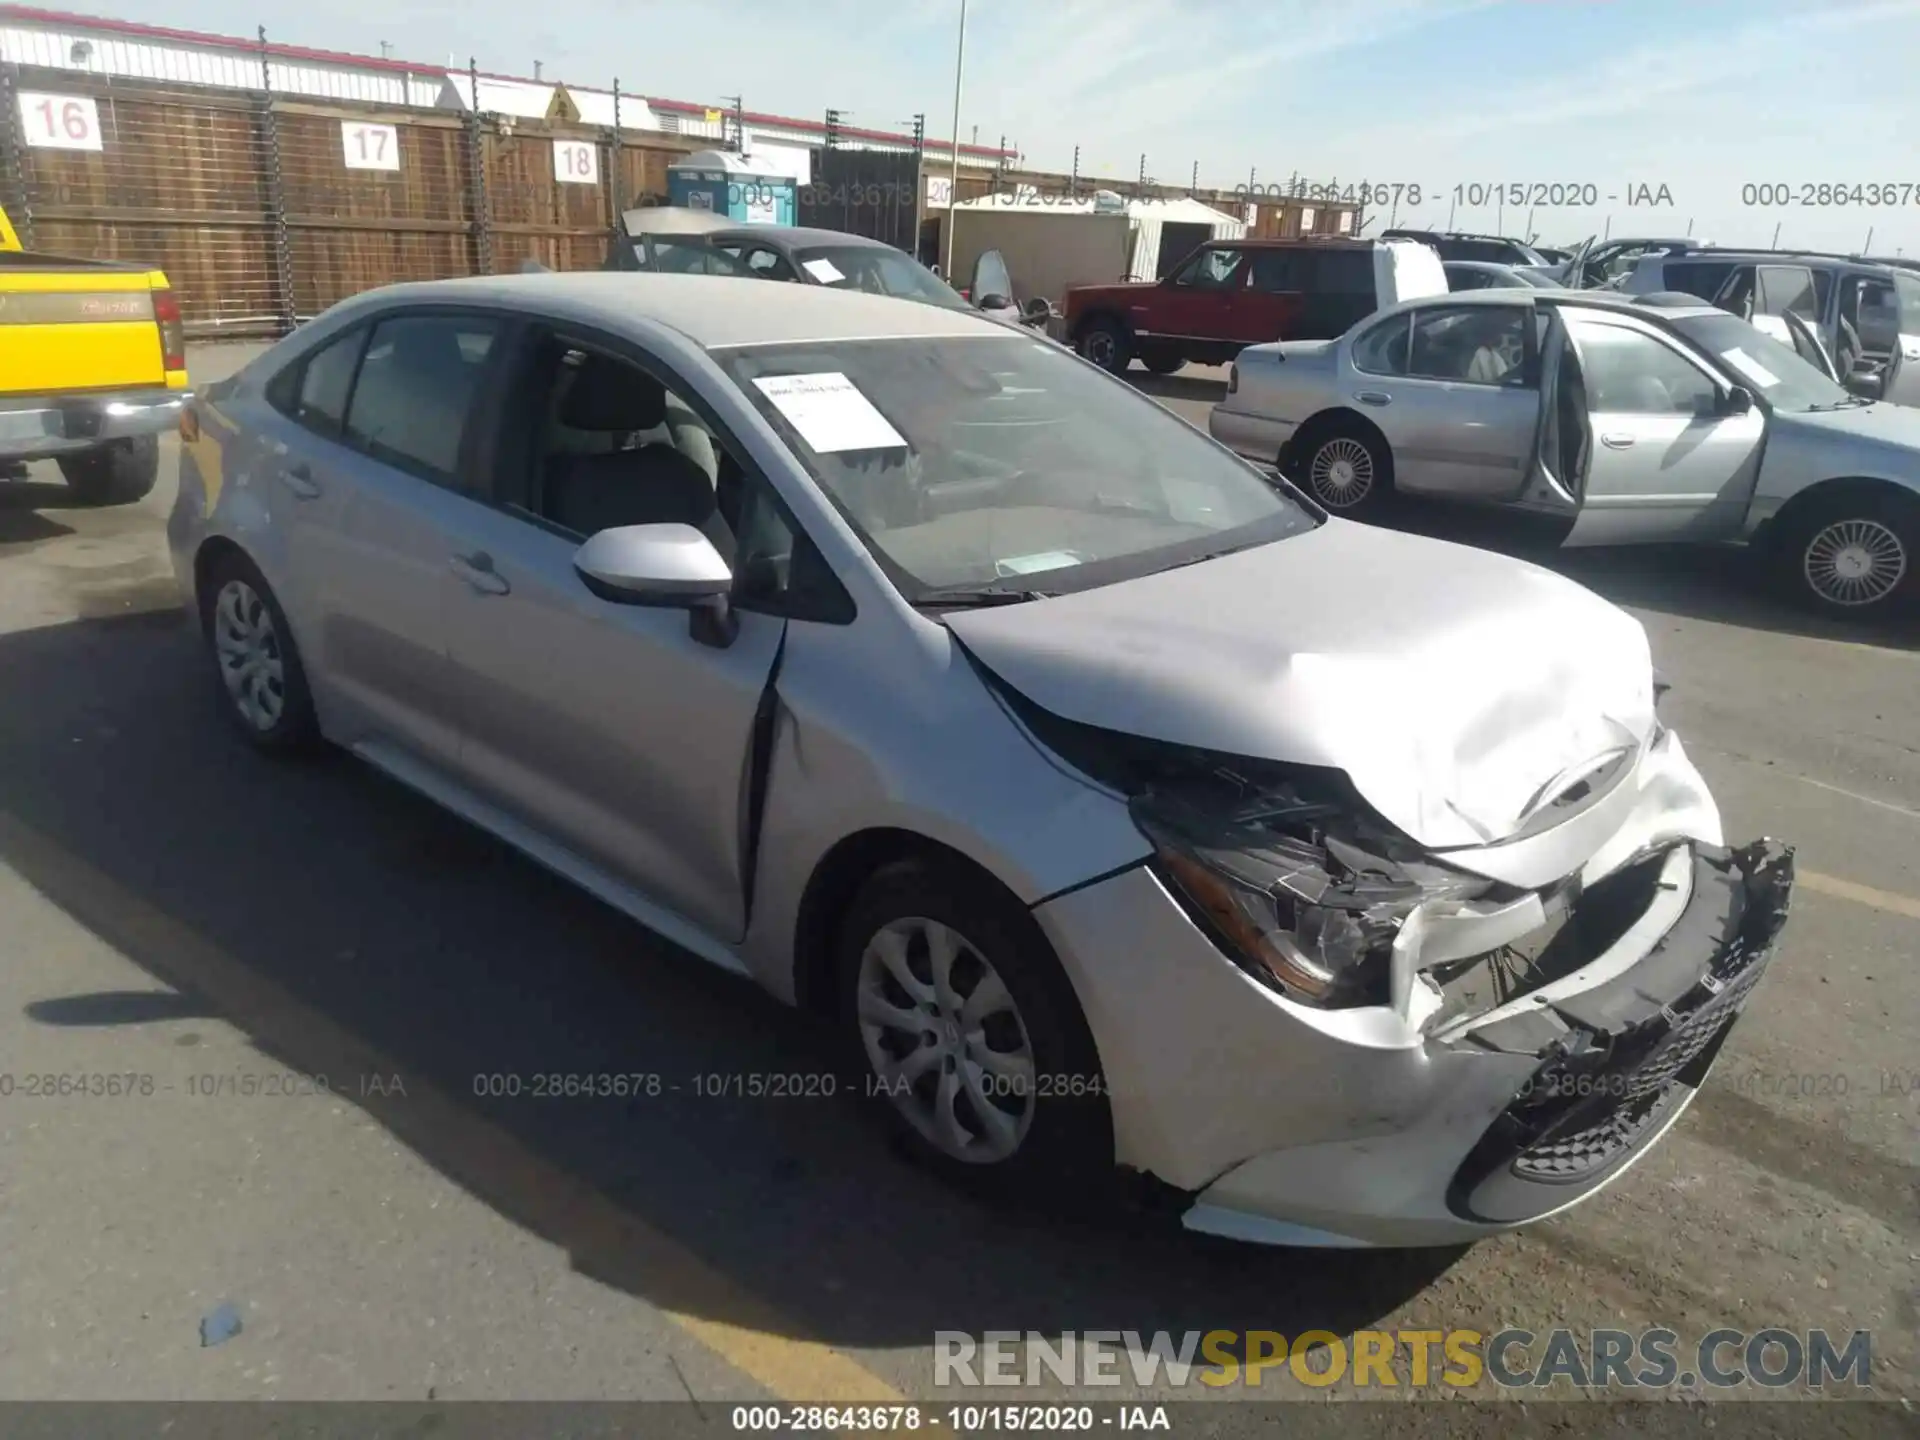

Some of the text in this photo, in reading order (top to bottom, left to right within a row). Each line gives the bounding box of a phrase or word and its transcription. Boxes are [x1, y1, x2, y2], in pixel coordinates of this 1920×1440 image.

[36, 99, 88, 140] 16
[352, 128, 388, 161] 17
[562, 147, 591, 176] 18
